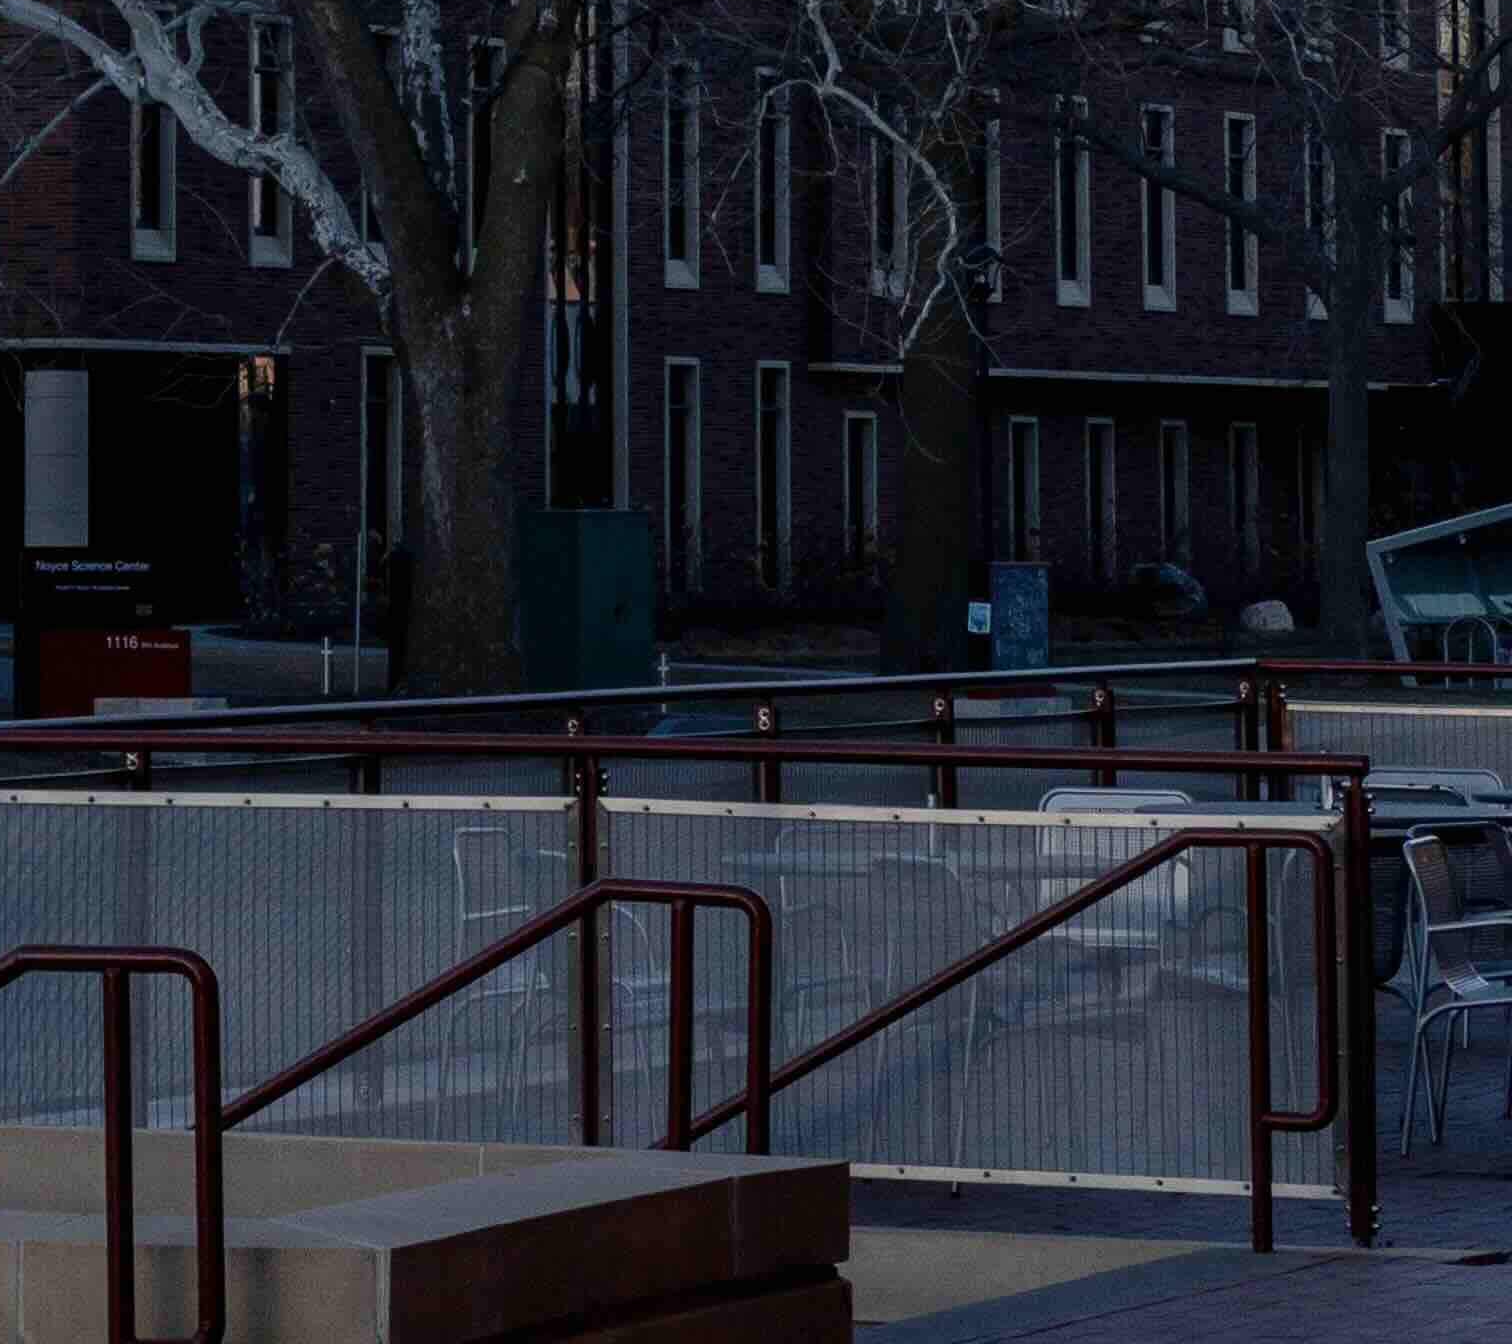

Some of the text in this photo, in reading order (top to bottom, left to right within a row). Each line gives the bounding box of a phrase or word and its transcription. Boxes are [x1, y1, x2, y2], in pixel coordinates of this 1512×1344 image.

[71, 559, 113, 572] Science
[114, 559, 152, 572] Center
[106, 635, 139, 649] 1116
